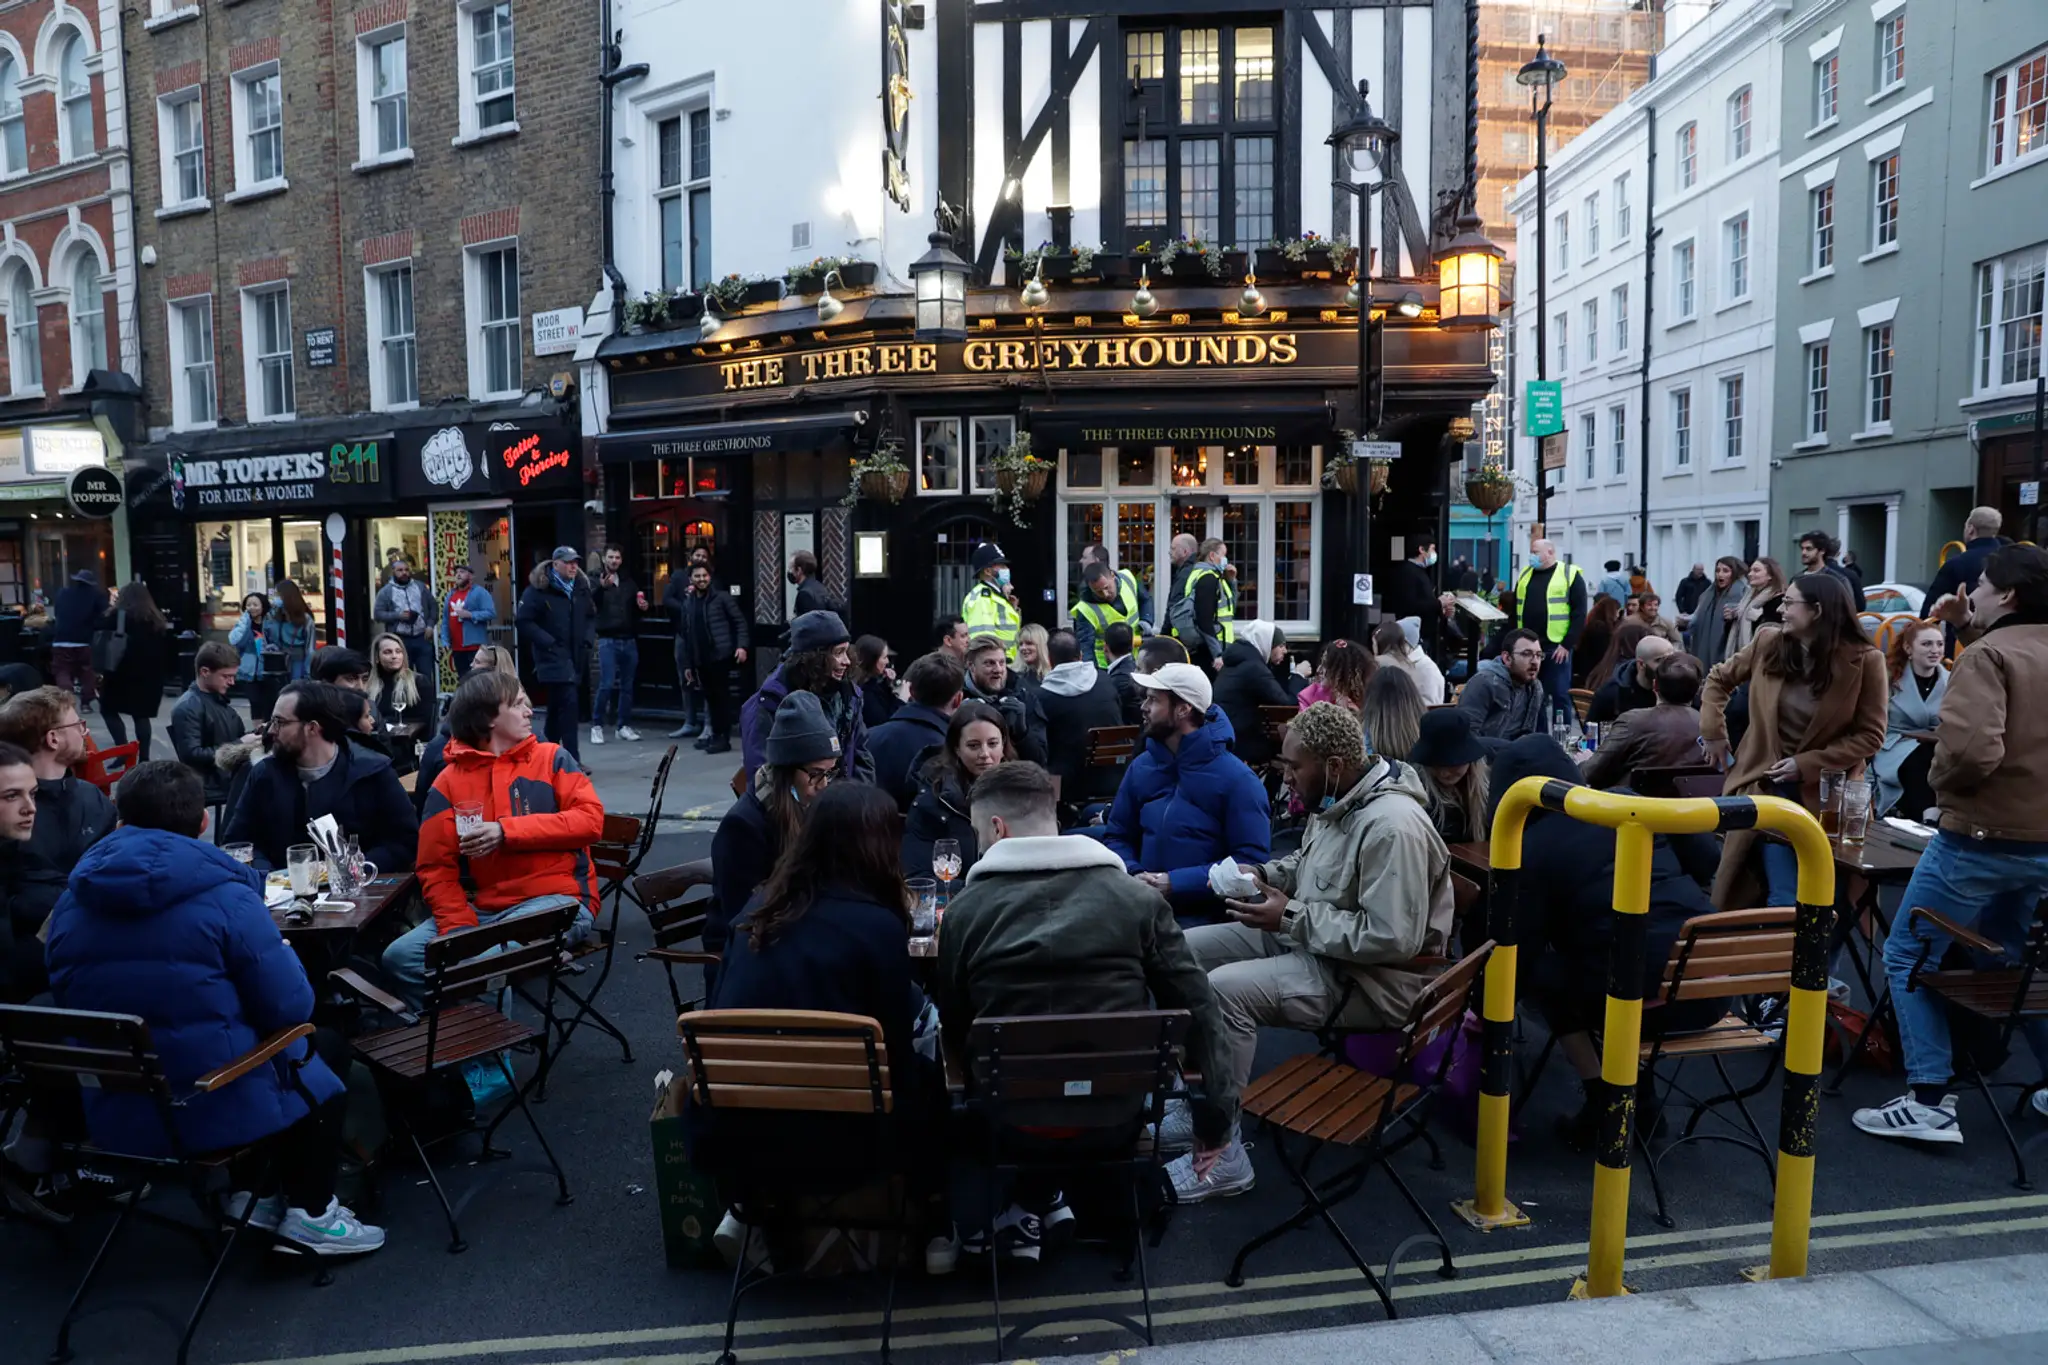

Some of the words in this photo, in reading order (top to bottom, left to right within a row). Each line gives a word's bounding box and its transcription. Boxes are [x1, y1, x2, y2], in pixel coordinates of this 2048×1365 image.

[537, 314, 560, 328] MOOR
[306, 333, 316, 347] TO
[537, 326, 565, 341] STREET
[567, 324, 579, 337] W1
[720, 357, 785, 390] THE
[801, 343, 937, 381] THREE
[962, 334, 1299, 372] GREYHOUNDS
[1082, 427, 1112, 440] THE
[1115, 427, 1164, 440] THREE
[1167, 426, 1277, 440] GREYHOUNDS
[503, 433, 540, 469] Tattoo
[652, 443, 671, 455] THE
[672, 440, 702, 453] THREE
[703, 435, 772, 452] GREYHOUNDS
[531, 448, 541, 461] &
[184, 460, 221, 487] MR
[221, 451, 326, 485] TOPPERS
[329, 441, 380, 484] £11
[519, 449, 570, 486] Piercing
[86, 480, 107, 491] MR
[199, 489, 222, 505] FOR
[224, 487, 252, 503] MEN
[254, 487, 264, 501] &
[264, 483, 315, 500] WOMEN
[73, 493, 122, 503] TOPPERS
